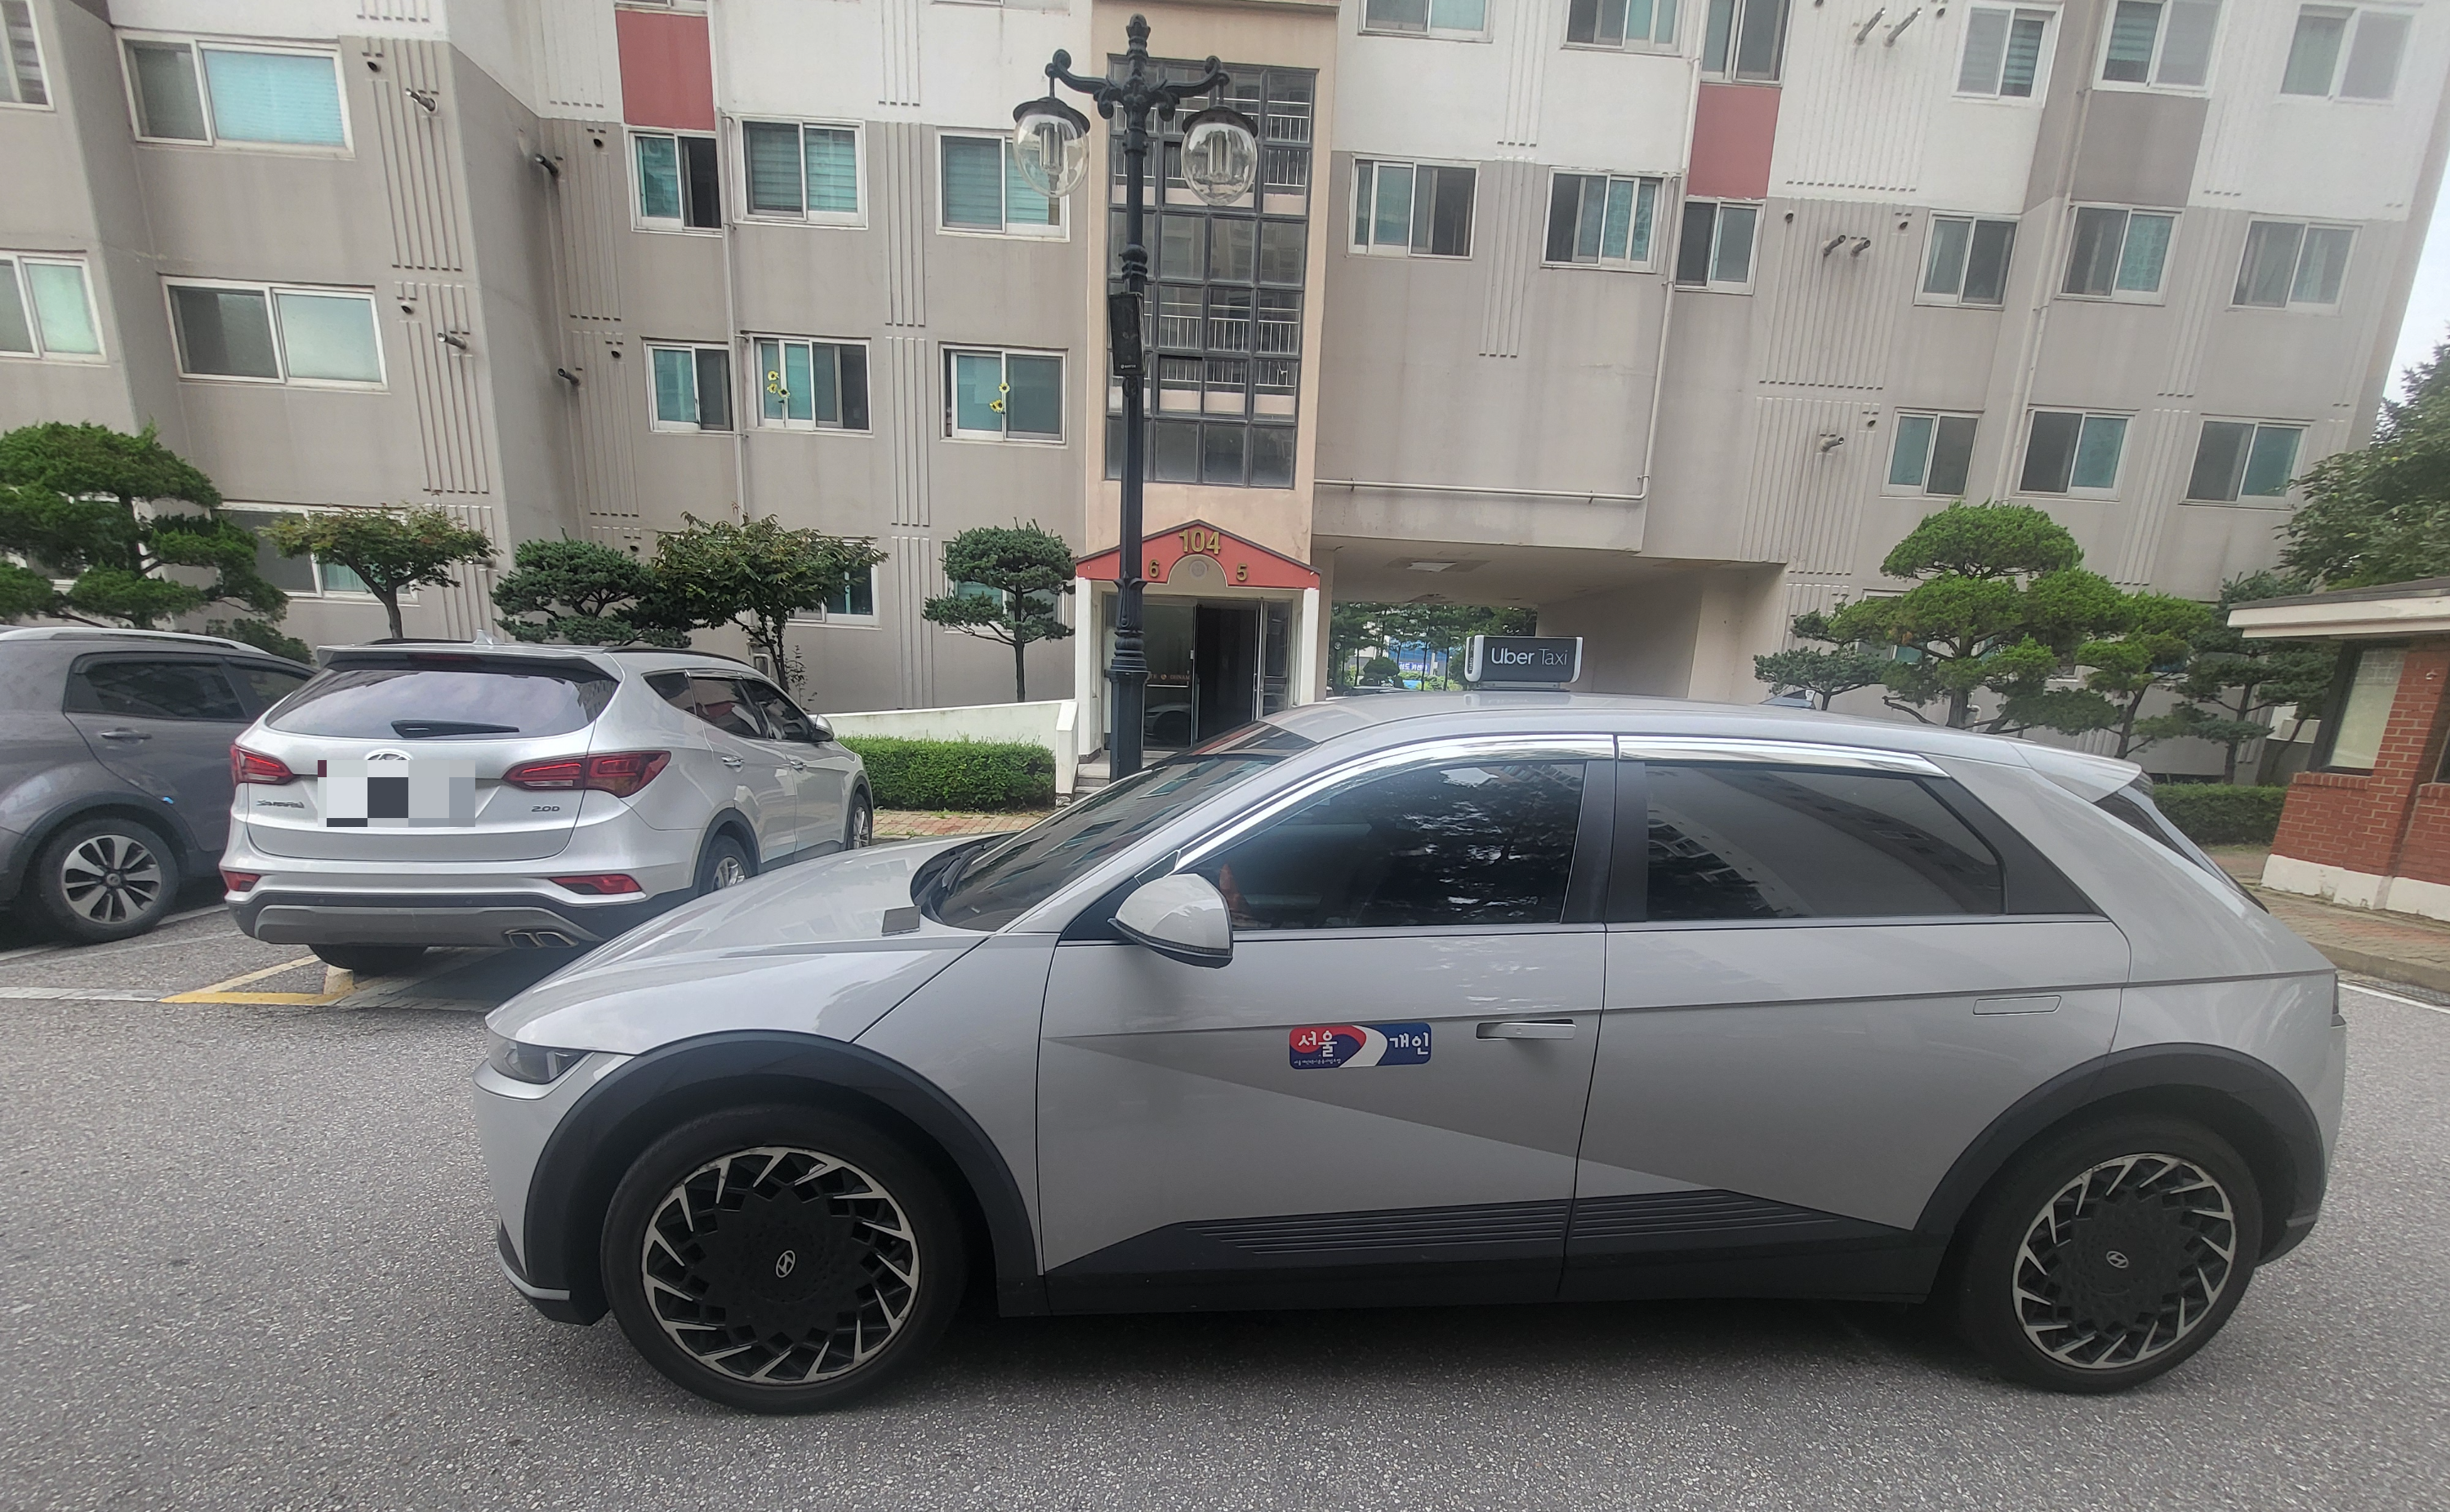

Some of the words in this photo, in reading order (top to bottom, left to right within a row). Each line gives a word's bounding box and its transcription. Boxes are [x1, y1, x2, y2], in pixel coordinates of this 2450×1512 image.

[1178, 529, 1221, 554] 104
[1148, 559, 1160, 578] 6
[1236, 563, 1248, 581] 5
[1491, 647, 1535, 665] Uber
[1539, 648, 1568, 665] Taxi
[1298, 1030, 1338, 1058] 서울
[1389, 1032, 1429, 1056] 개인
